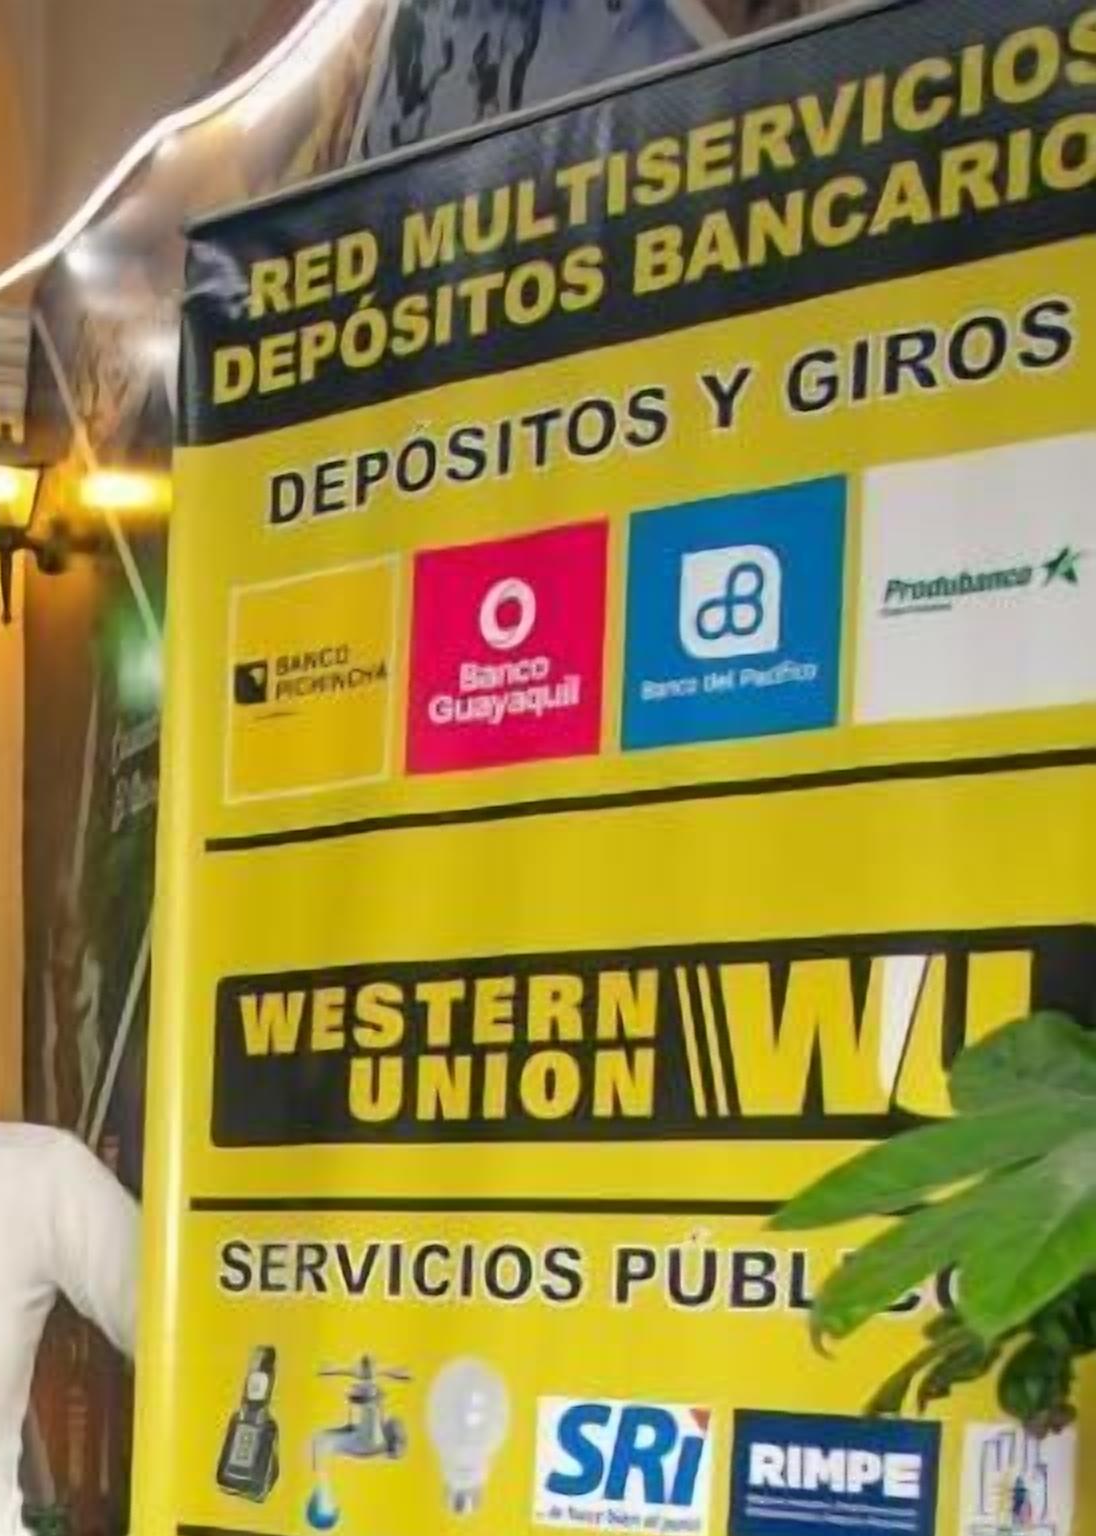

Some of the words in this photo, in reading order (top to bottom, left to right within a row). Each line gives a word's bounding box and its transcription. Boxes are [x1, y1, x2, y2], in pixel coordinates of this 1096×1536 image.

[247, 231, 379, 319] RED
[213, 246, 605, 405] DEPÓSITOS
[270, 387, 668, 525] DEPÓSITOS
[701, 366, 752, 430] Y
[787, 300, 1073, 413] GIROS
[428, 675, 581, 726] Guayaquil
[460, 657, 550, 691] Banco
[641, 677, 699, 700] Banco
[705, 670, 734, 693] del
[239, 966, 659, 1057] WESTERN
[348, 1047, 657, 1123] UNION
[218, 1238, 582, 1303] SERVICIOS
[746, 1442, 922, 1499] RIMPE
